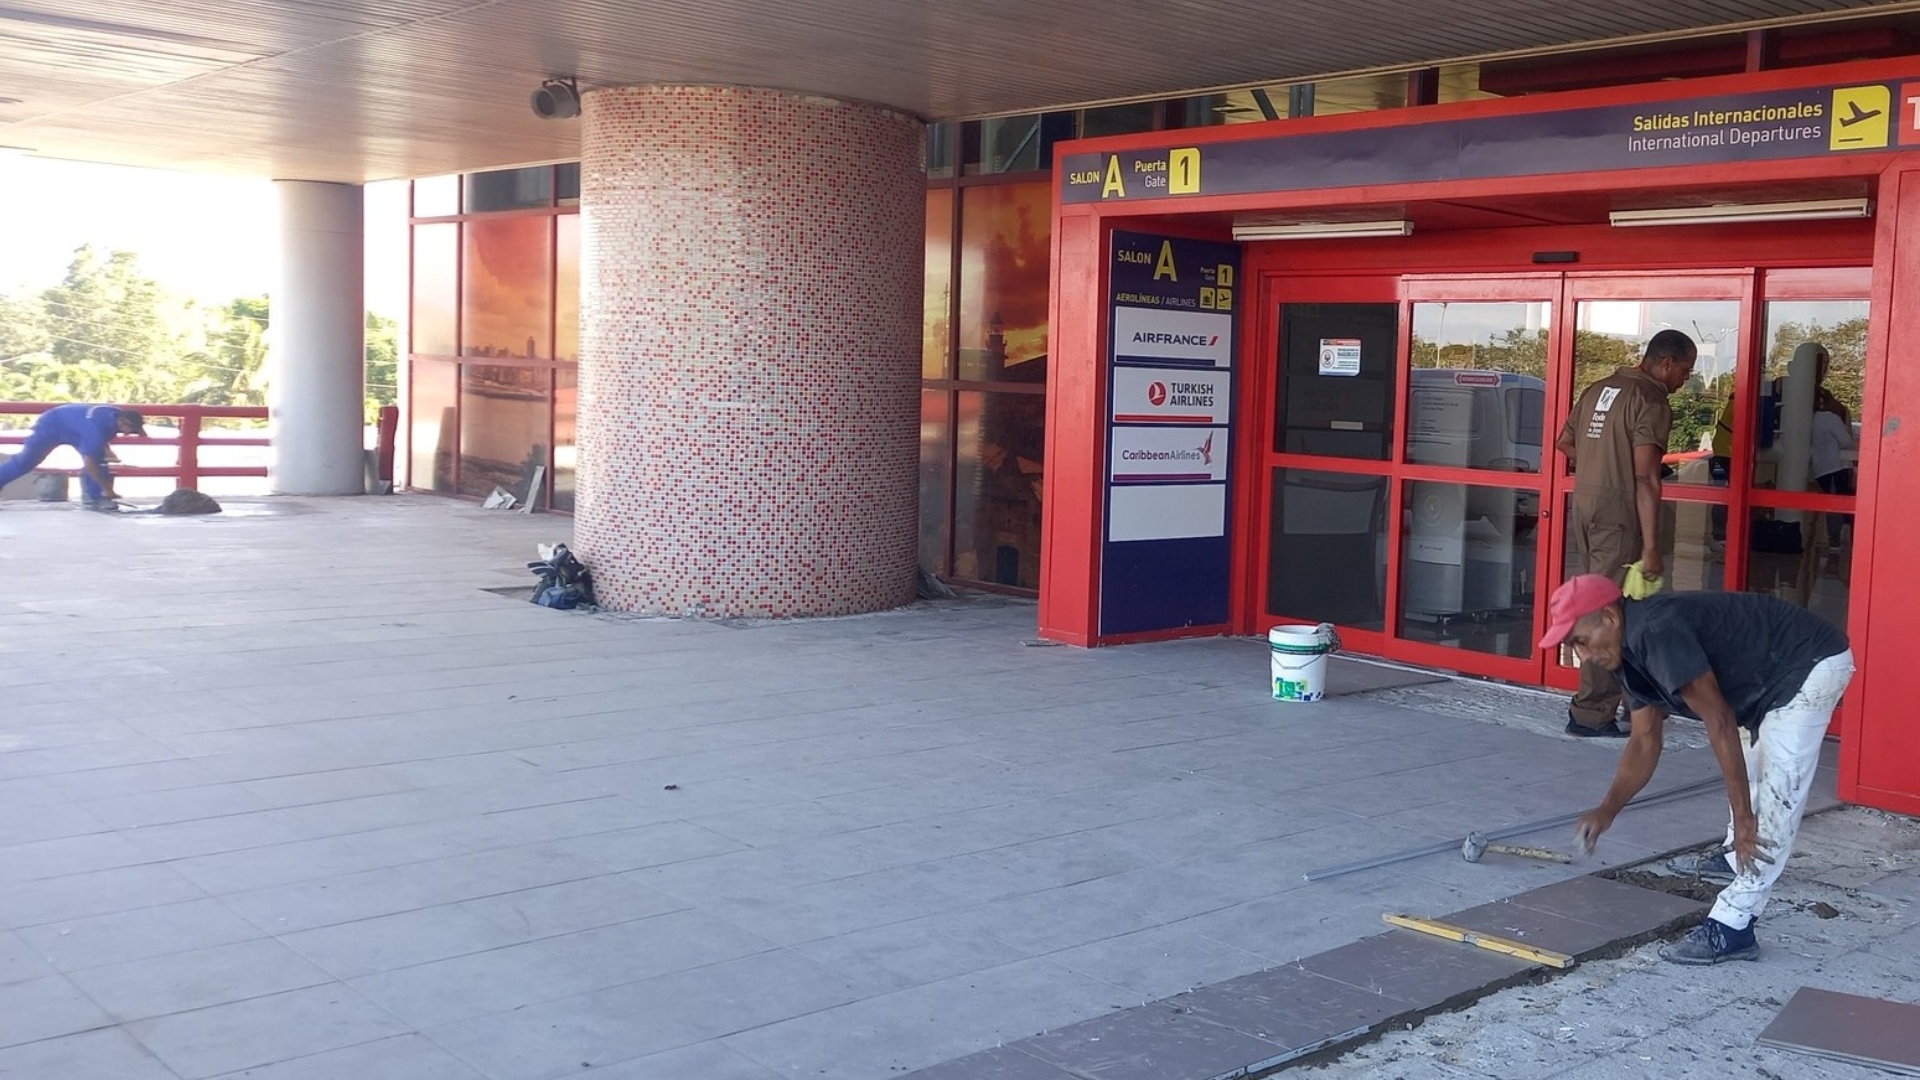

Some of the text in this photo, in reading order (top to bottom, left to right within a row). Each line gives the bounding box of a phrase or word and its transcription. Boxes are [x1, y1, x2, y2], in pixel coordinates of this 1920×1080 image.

[1633, 101, 1823, 132] Salidas Internacionales
[1628, 124, 1822, 152] International Departures
[1135, 160, 1166, 173] Puerta
[1179, 156, 1189, 186] 1
[1070, 154, 1125, 198] SALON A
[1145, 175, 1166, 188] Gate
[1117, 240, 1177, 282] SALON A
[1222, 267, 1228, 283] 1
[1165, 298, 1196, 308] AIRLINES
[1132, 331, 1207, 346] AIRFRANCE
[1171, 382, 1214, 395] TURKISH
[1170, 394, 1214, 407] AIRLINES
